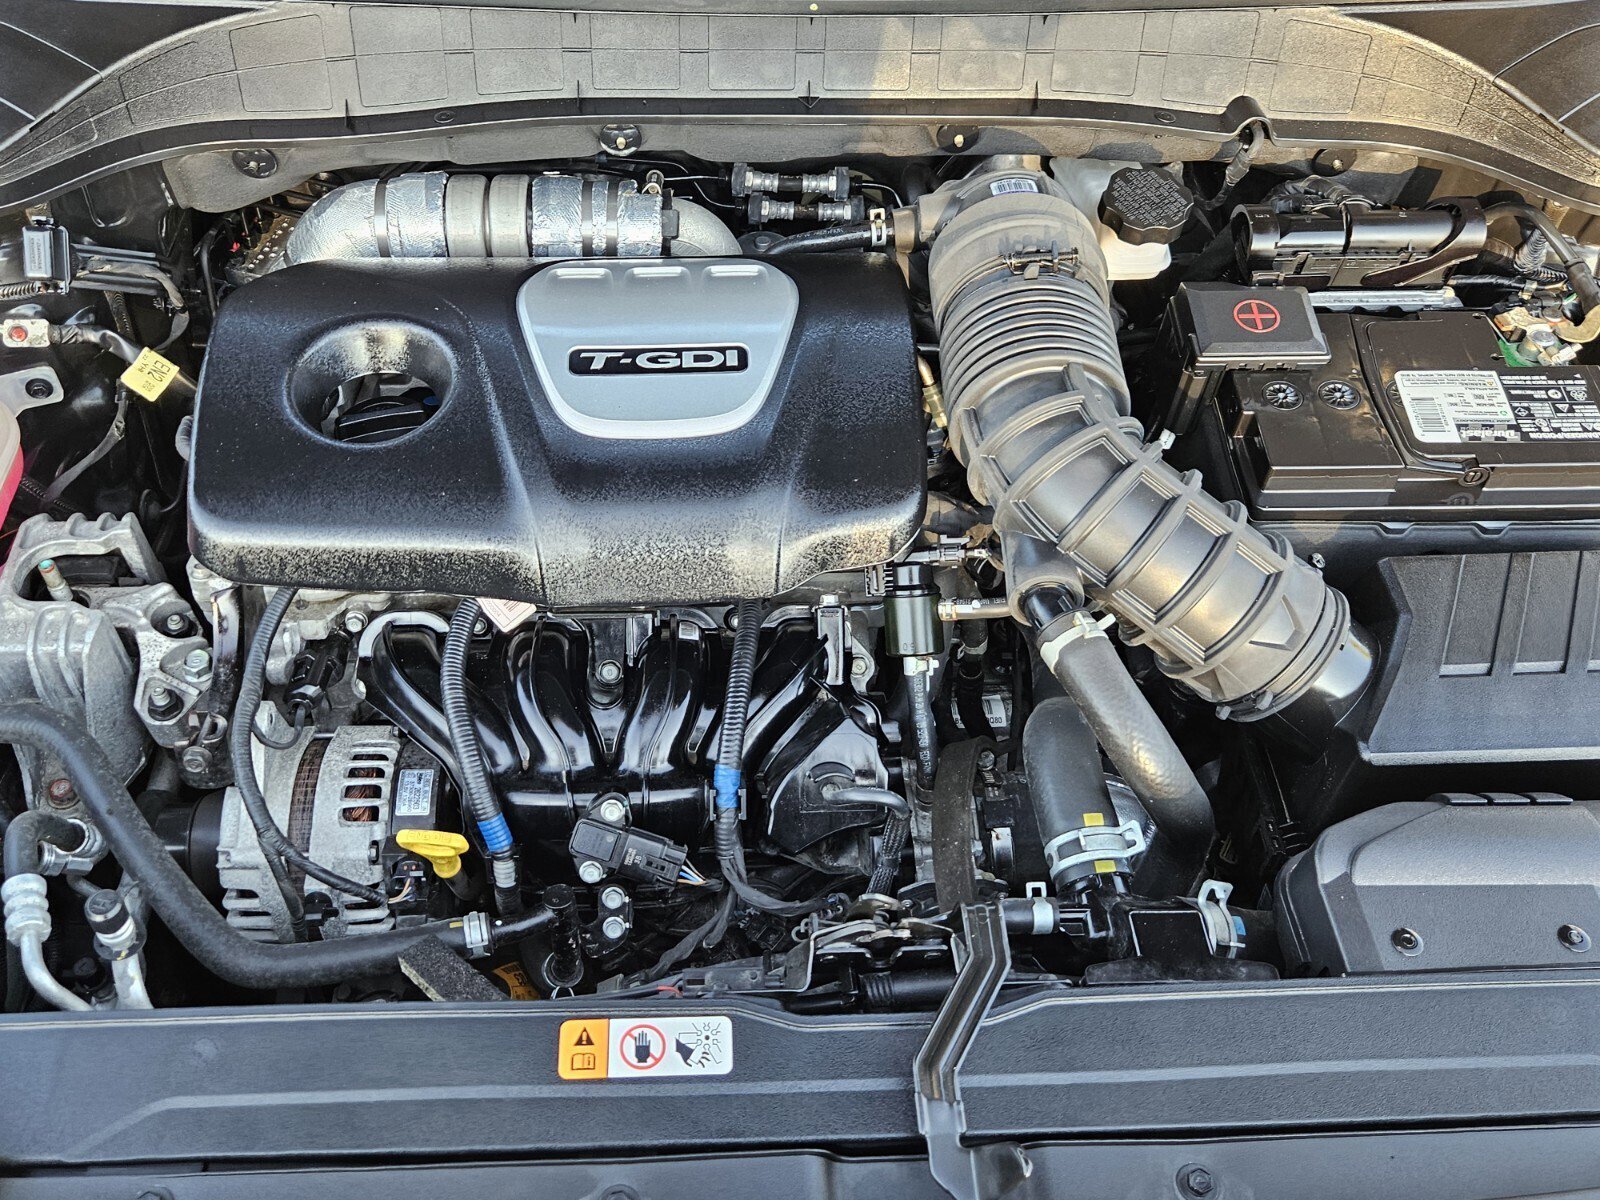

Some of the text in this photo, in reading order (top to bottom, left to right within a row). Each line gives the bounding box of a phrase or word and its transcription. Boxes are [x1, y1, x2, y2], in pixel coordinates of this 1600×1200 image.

[147, 360, 171, 382] EN2
[580, 350, 739, 371] T-GDI
[1460, 429, 1518, 438] Duralast
